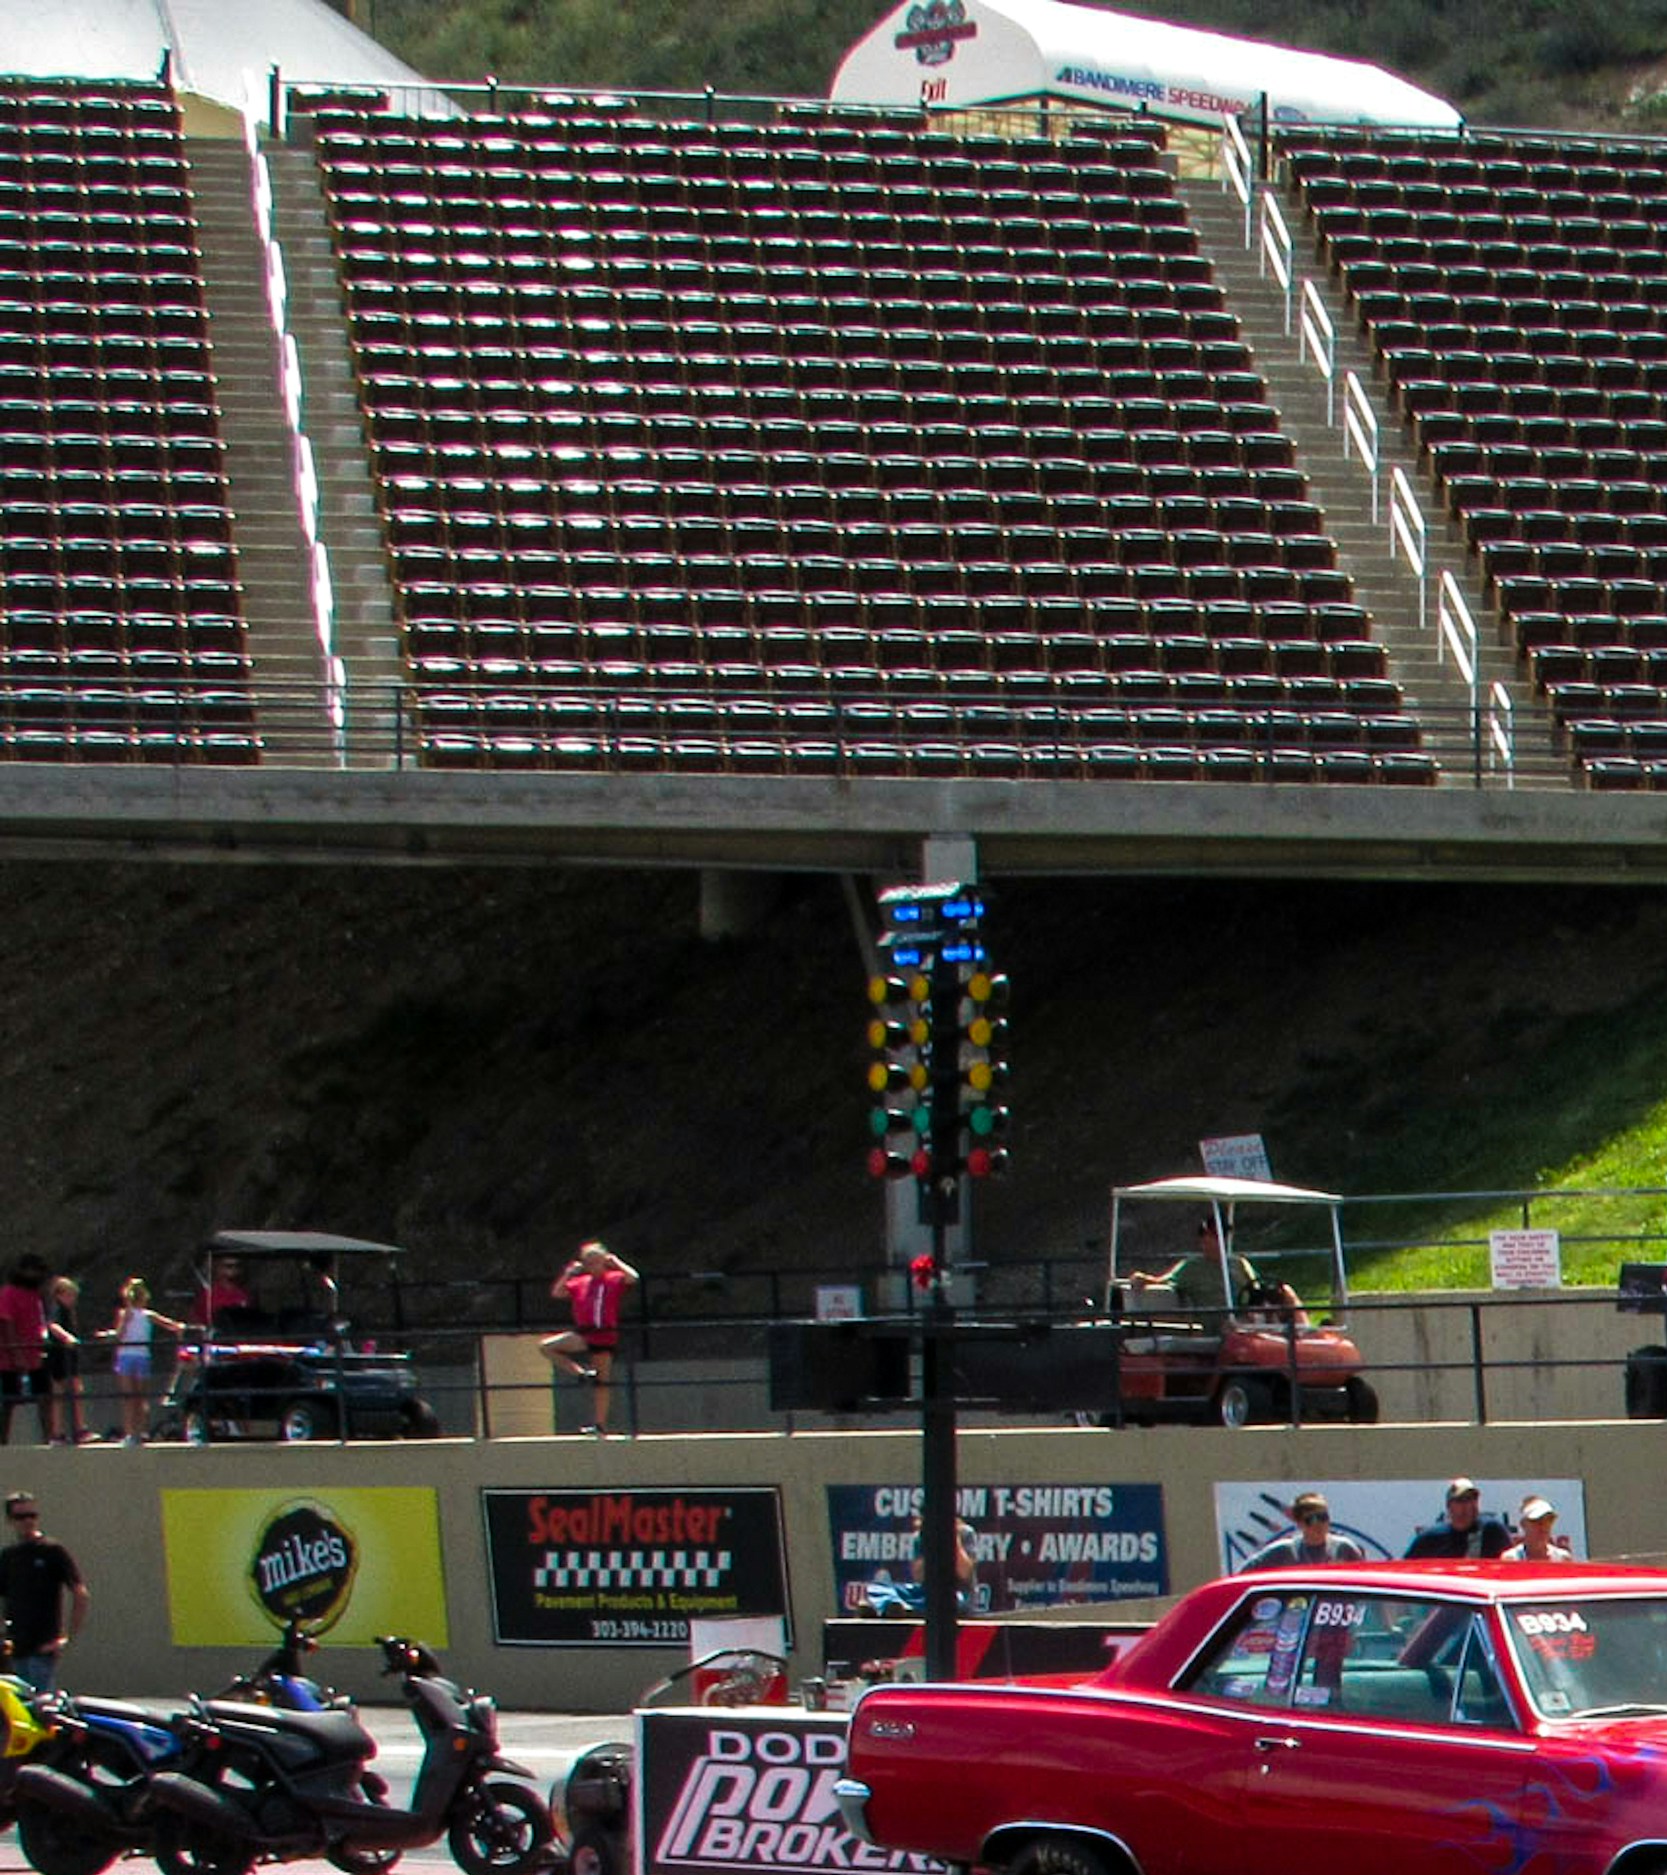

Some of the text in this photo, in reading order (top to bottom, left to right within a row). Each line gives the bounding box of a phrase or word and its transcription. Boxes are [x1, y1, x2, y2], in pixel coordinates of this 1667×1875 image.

[1073, 67, 1165, 101] BANDIMERE
[875, 1488, 1113, 1517] CUSM T-SHIRTS
[529, 1496, 722, 1543] SealMaster
[260, 1531, 348, 1592] mike's
[1038, 1533, 1158, 1563] AWARDS
[1315, 1603, 1366, 1626] B934
[1517, 1612, 1588, 1634] B934
